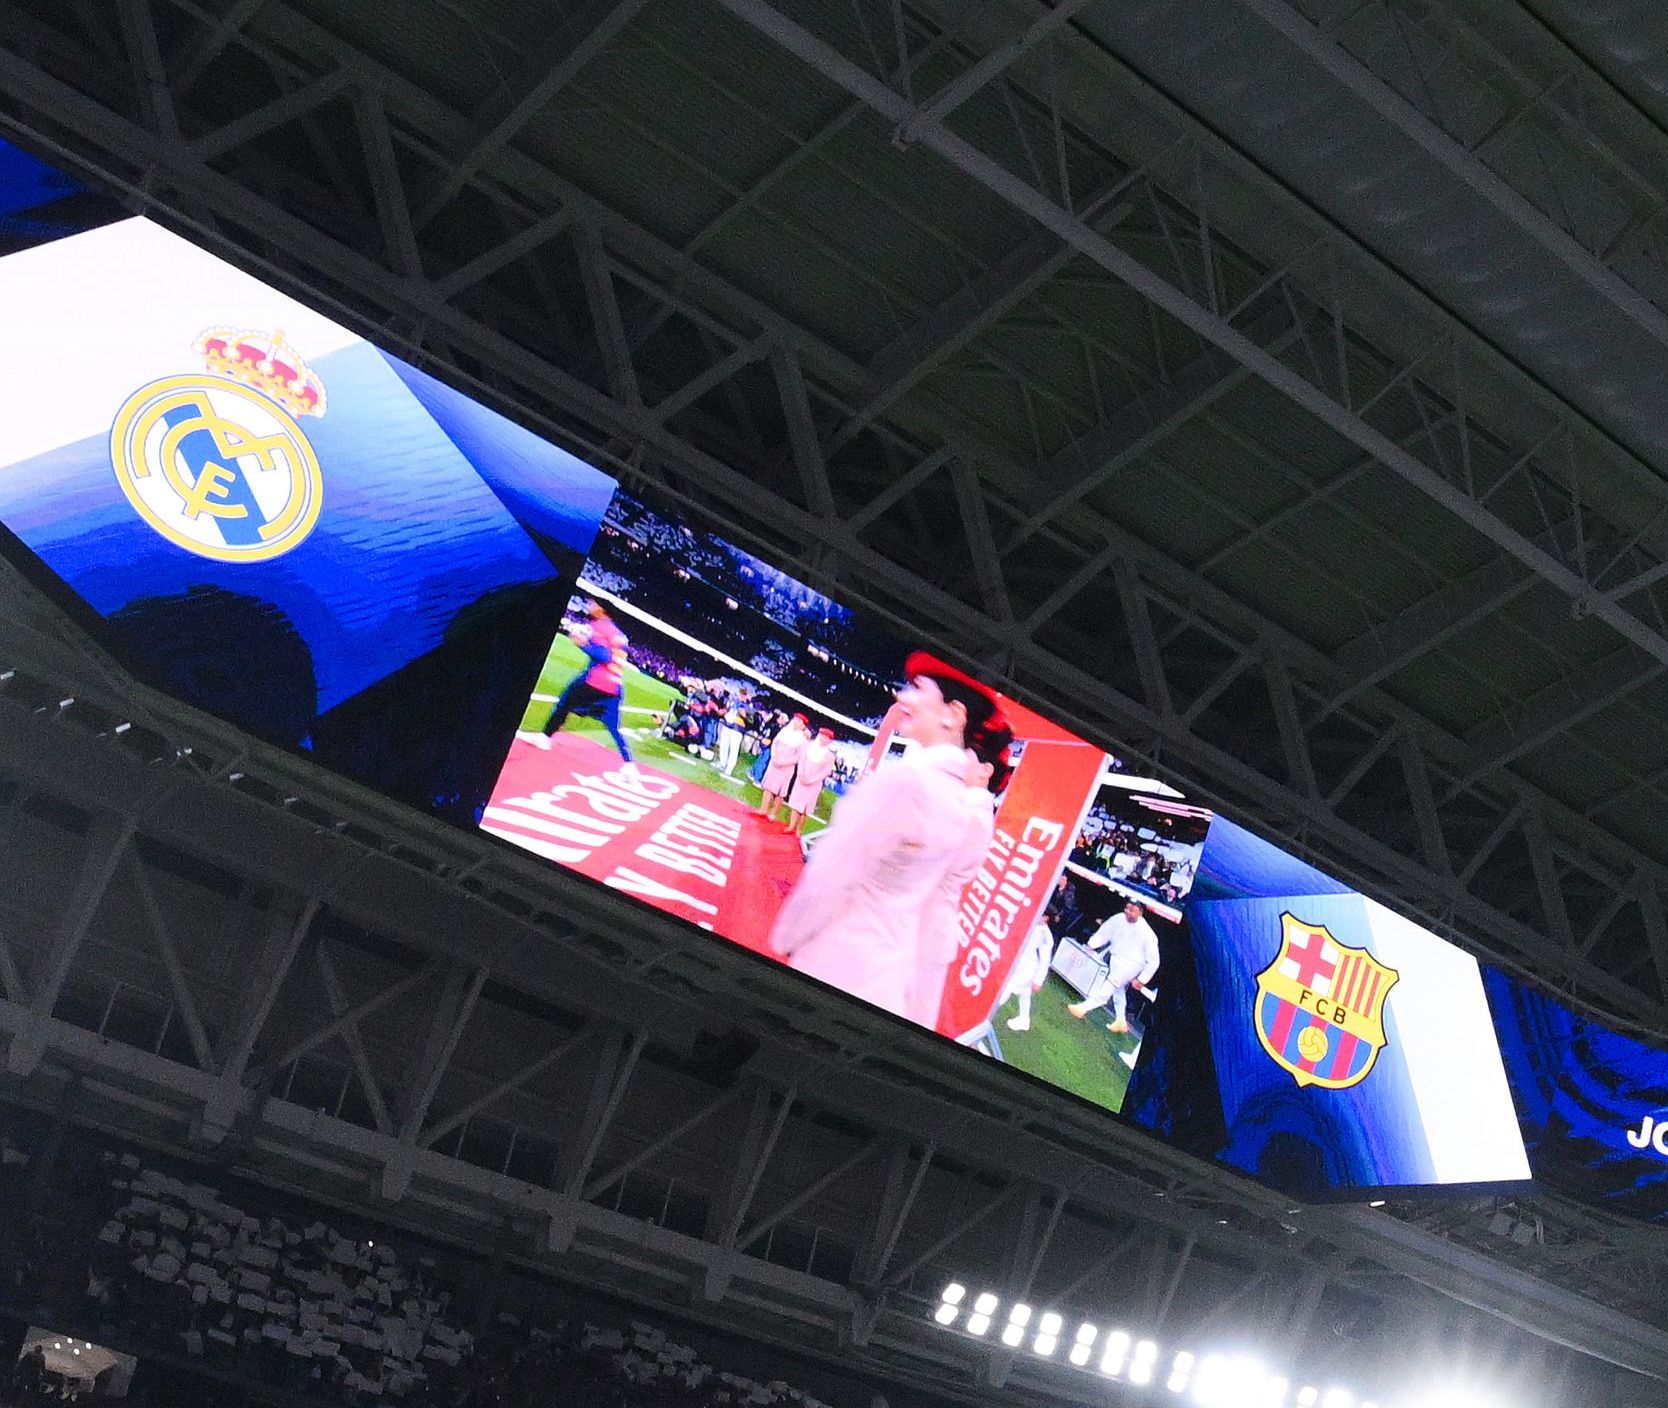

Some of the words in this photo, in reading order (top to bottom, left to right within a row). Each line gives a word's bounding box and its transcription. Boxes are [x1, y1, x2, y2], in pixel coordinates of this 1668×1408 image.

[985, 828, 1016, 873] FLY
[960, 815, 1065, 997] Emirates
[1299, 989, 1346, 1025] FCB
